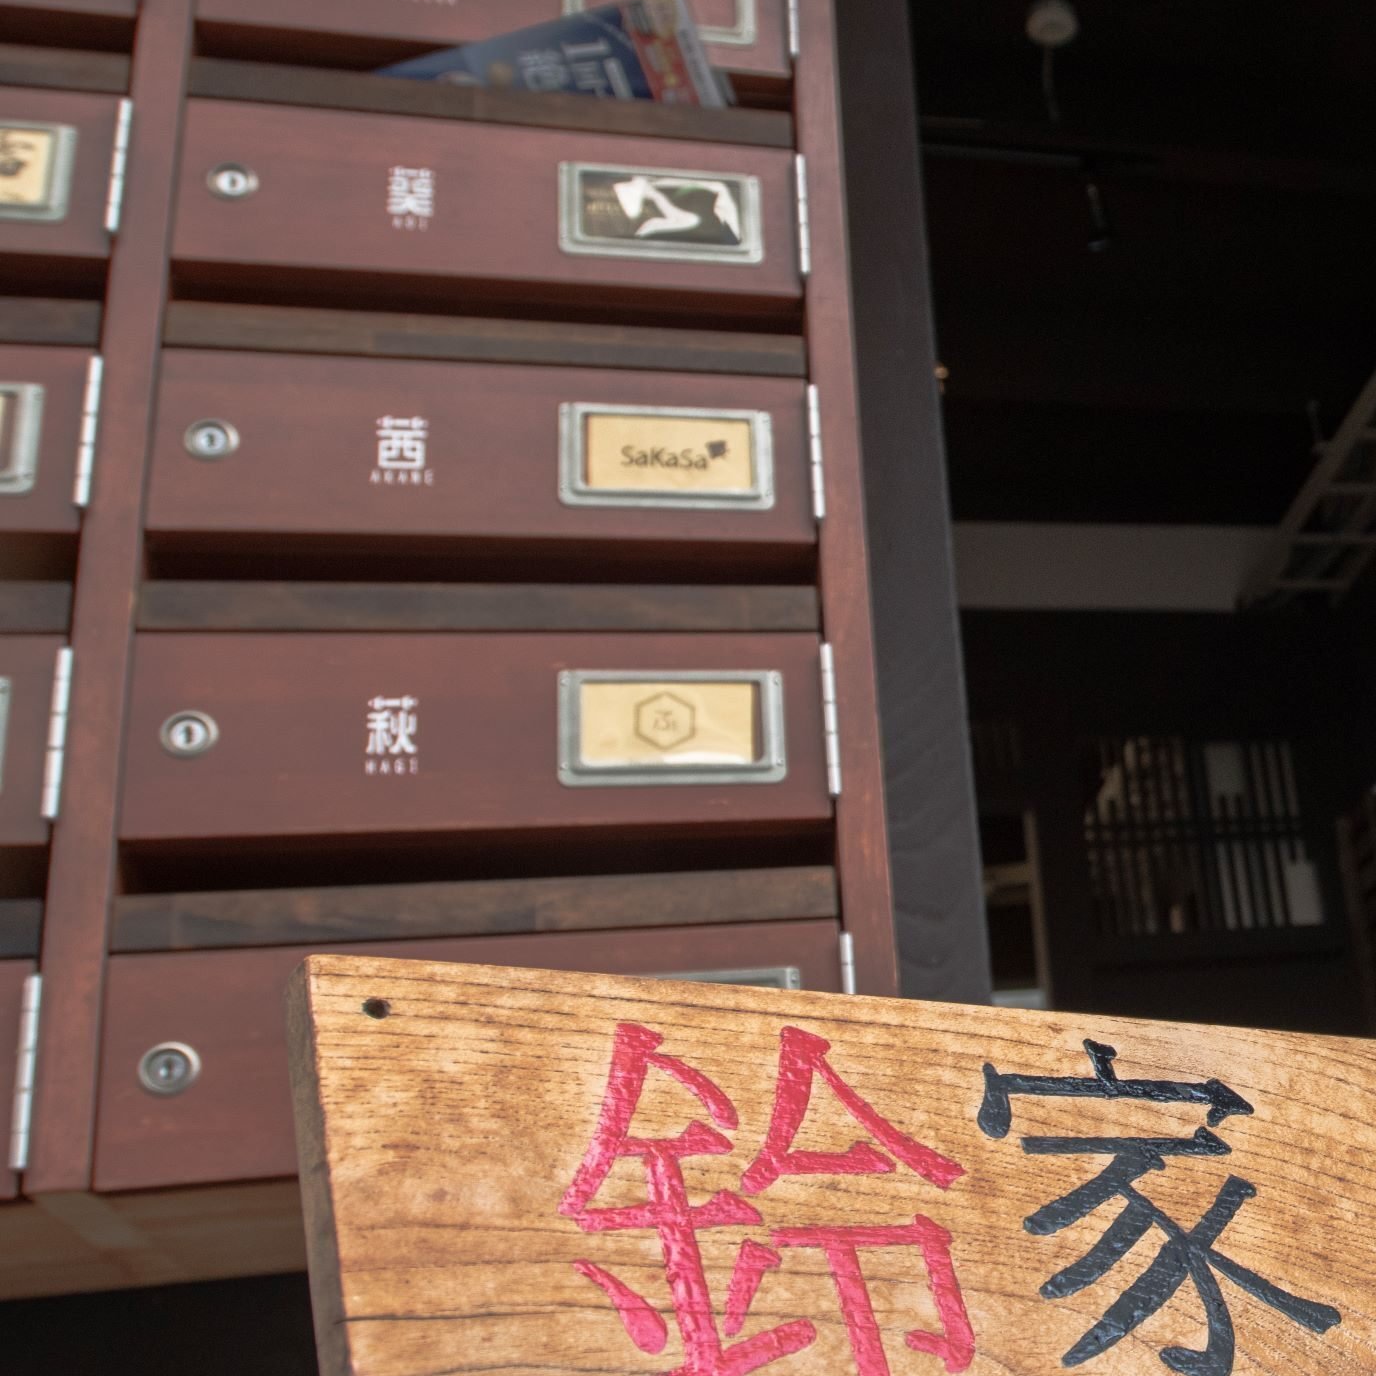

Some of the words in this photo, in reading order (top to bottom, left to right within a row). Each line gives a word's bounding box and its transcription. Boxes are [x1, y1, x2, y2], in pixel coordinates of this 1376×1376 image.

[375, 415, 429, 470] 茜
[620, 444, 710, 471] SaKaSa
[365, 695, 419, 756] 萩
[364, 757, 419, 776] HAGI
